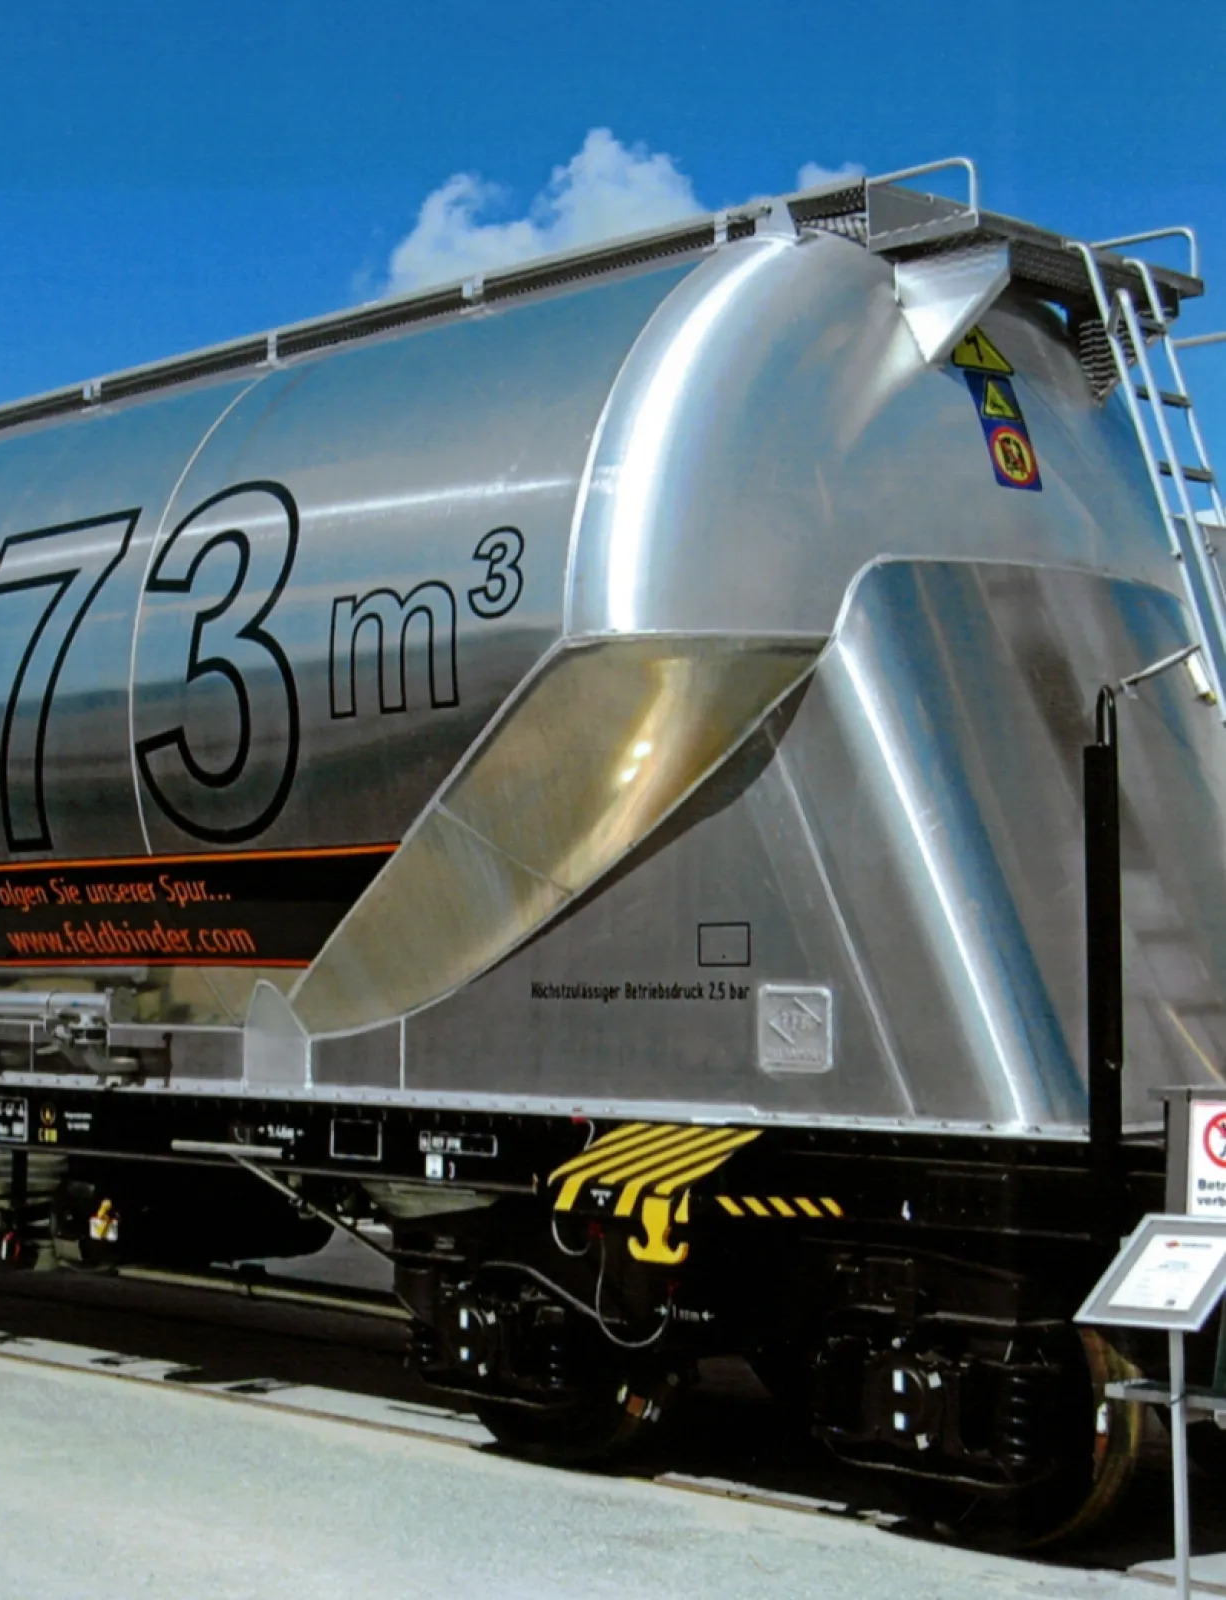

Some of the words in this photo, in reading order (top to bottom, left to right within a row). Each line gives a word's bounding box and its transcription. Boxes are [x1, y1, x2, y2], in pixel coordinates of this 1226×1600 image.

[49, 876, 82, 904] Sie
[85, 880, 156, 904] unserer
[158, 873, 232, 908] Spur...
[6, 919, 257, 953] www.feldbinder.com
[531, 981, 621, 1003] Höchstzulässiger
[624, 981, 703, 1000] Betriebsdruck
[729, 980, 751, 1000] bar
